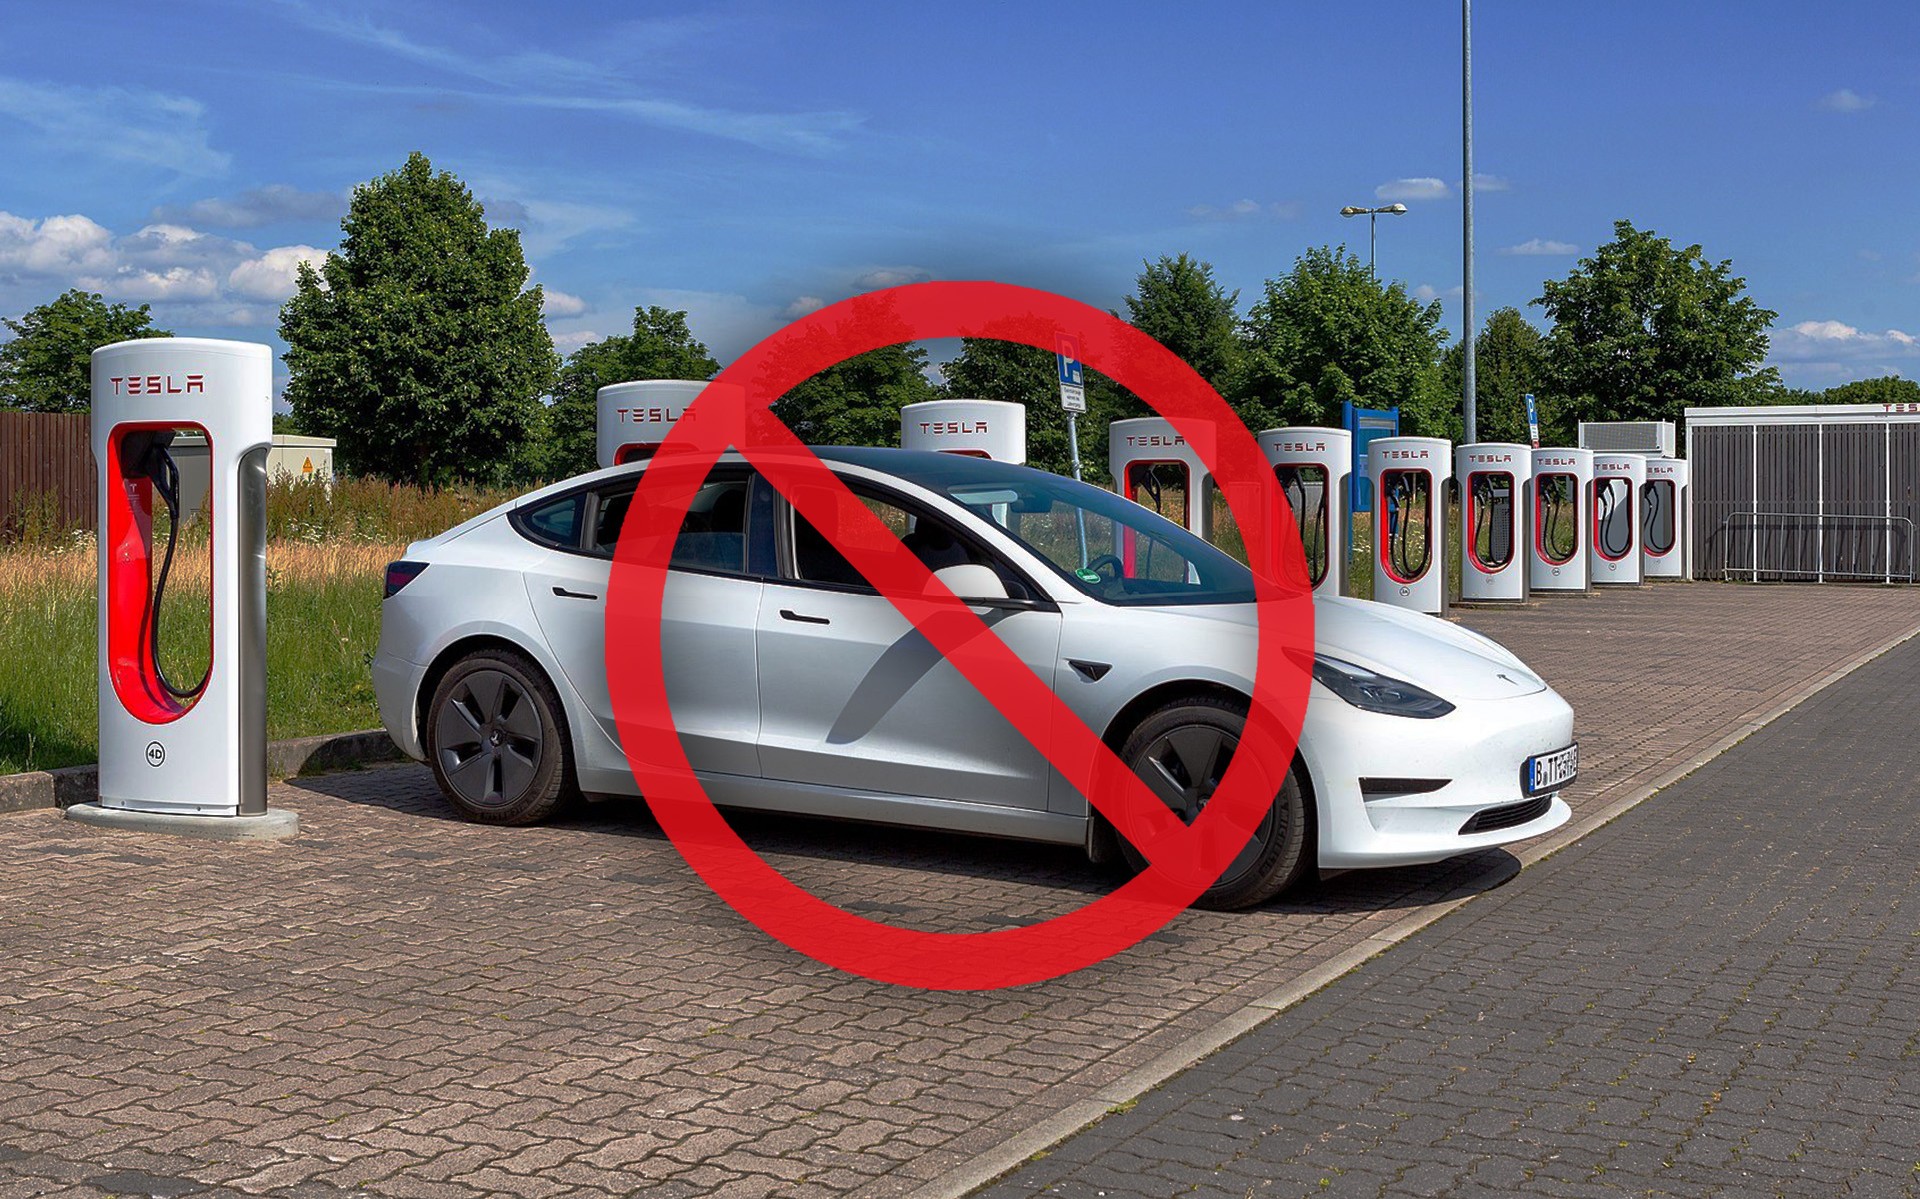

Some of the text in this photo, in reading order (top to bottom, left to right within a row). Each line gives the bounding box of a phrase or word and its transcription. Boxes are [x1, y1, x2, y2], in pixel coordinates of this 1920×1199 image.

[110, 375, 204, 395] TESLA
[616, 408, 697, 423] TESLA
[920, 421, 988, 435] TESLA
[1126, 436, 1185, 447] TESLA
[1274, 443, 1326, 452] TESLA
[1382, 450, 1429, 459] TESLA
[1469, 454, 1512, 463] TESLA
[1537, 458, 1576, 466] TESLA
[148, 749, 162, 759] 4D
